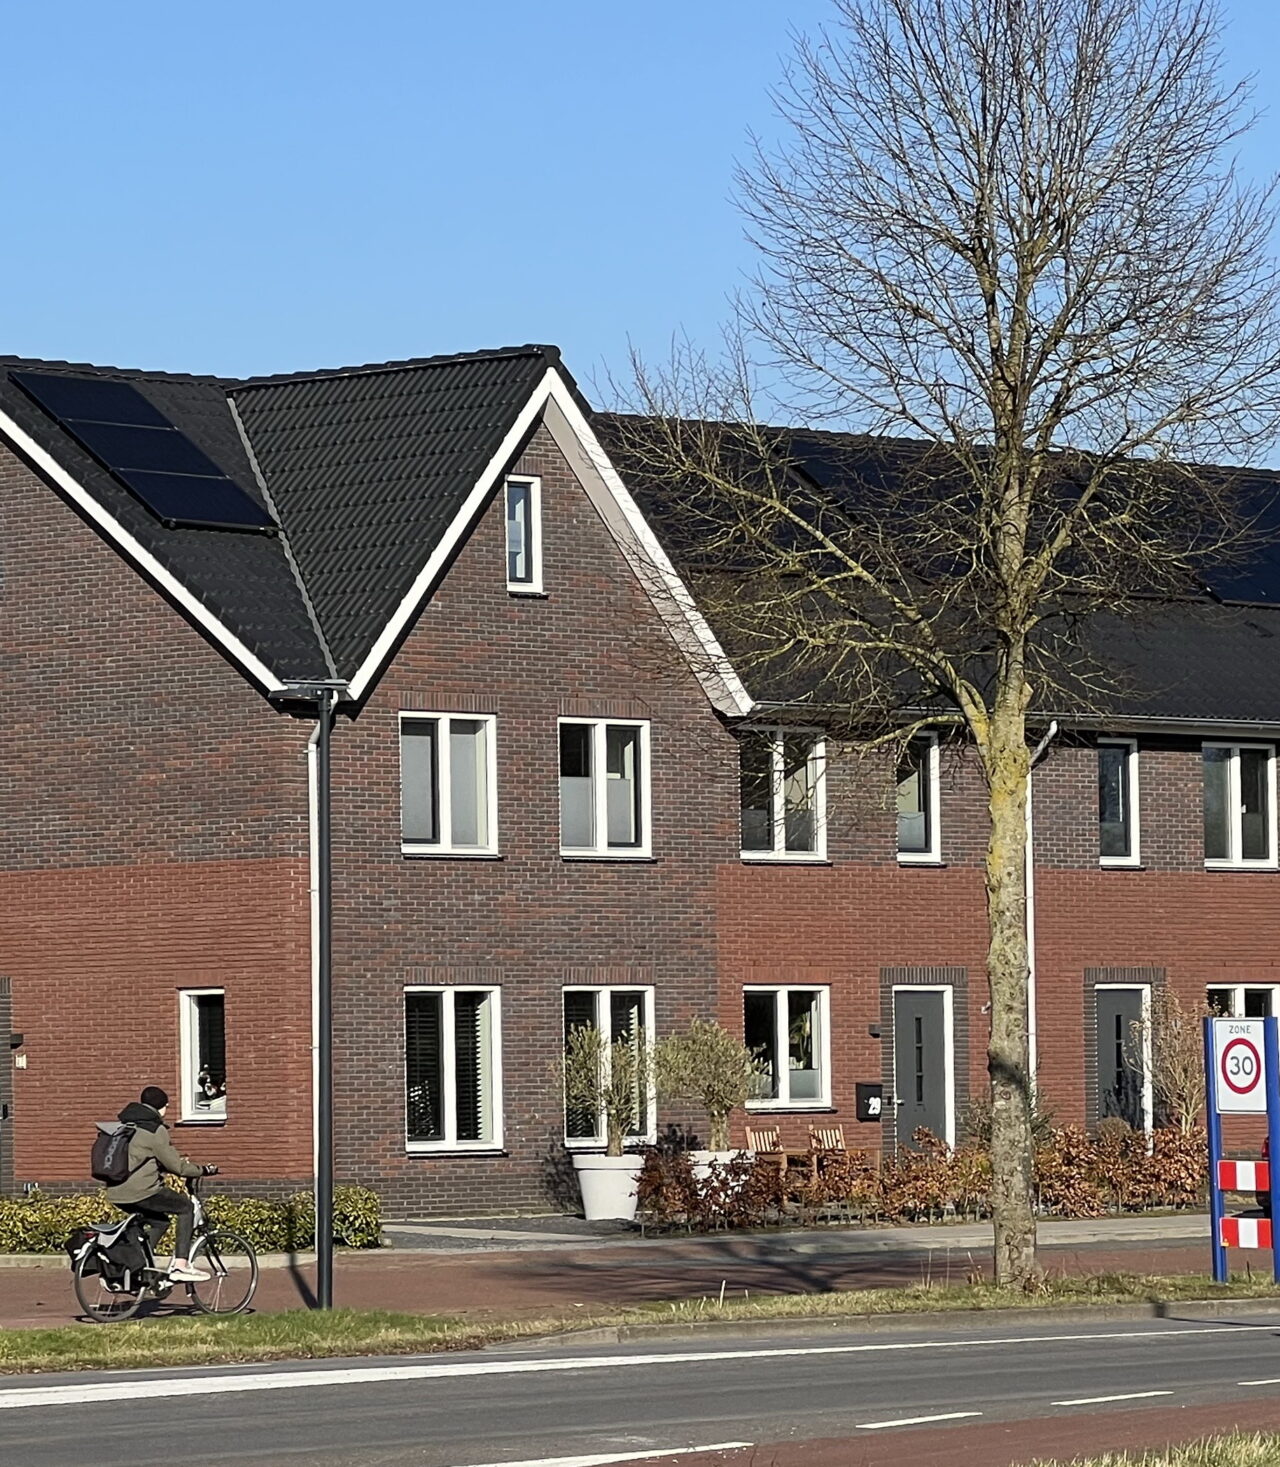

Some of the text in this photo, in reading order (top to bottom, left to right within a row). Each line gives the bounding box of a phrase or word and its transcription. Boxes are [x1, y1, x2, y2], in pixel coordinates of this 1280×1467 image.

[1228, 1024, 1252, 1034] ZONE
[1229, 1055, 1254, 1076] 30
[867, 1096, 882, 1115] 29
